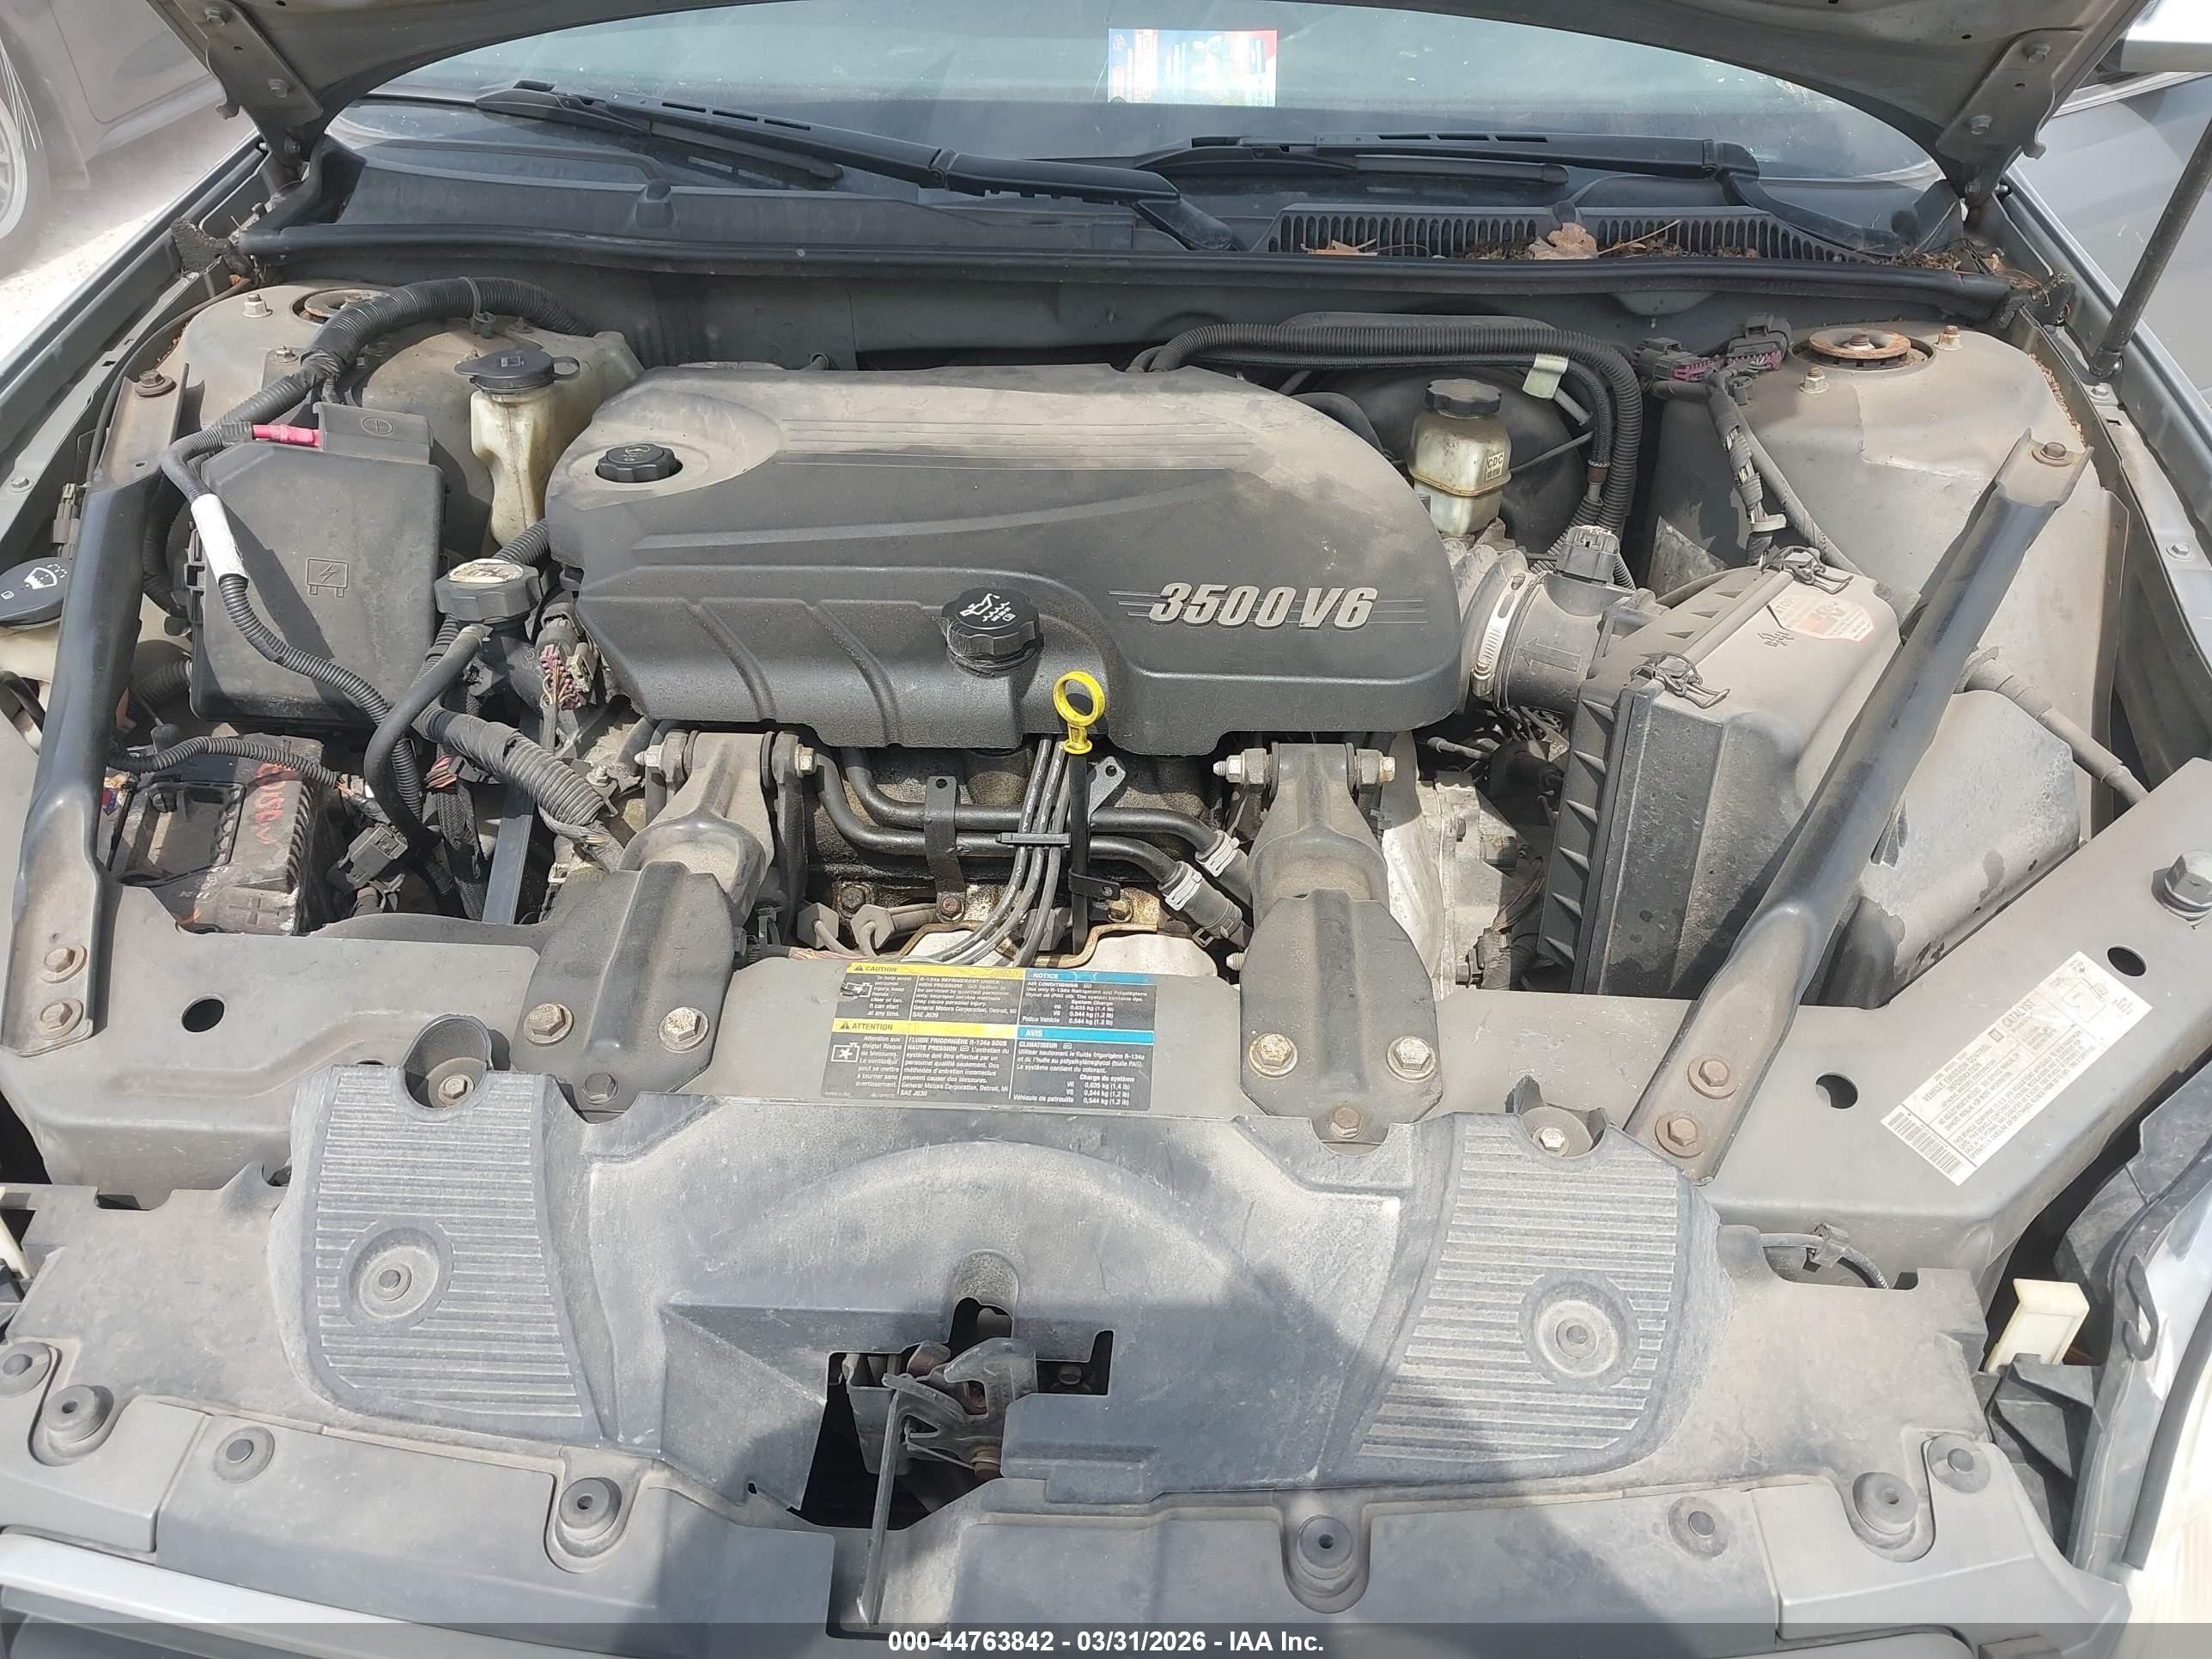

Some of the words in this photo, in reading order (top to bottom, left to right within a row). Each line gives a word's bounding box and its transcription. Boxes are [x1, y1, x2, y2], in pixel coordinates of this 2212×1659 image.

[1488, 455, 1503, 469] CDC
[1149, 582, 1297, 629] 3500
[1298, 587, 1378, 630] V6
[2000, 997, 2036, 1028] CATALYST
[1025, 1029, 1043, 1037] AVIS
[1079, 1073, 1101, 1082] Charge
[1110, 1075, 1135, 1084] système
[1921, 1081, 1946, 1102] VEHICLE
[1942, 1060, 1970, 1084] EMISSION
[1102, 1083, 1109, 1091] kg
[1101, 1091, 1109, 1099] kg
[1101, 1097, 1109, 1107] kg
